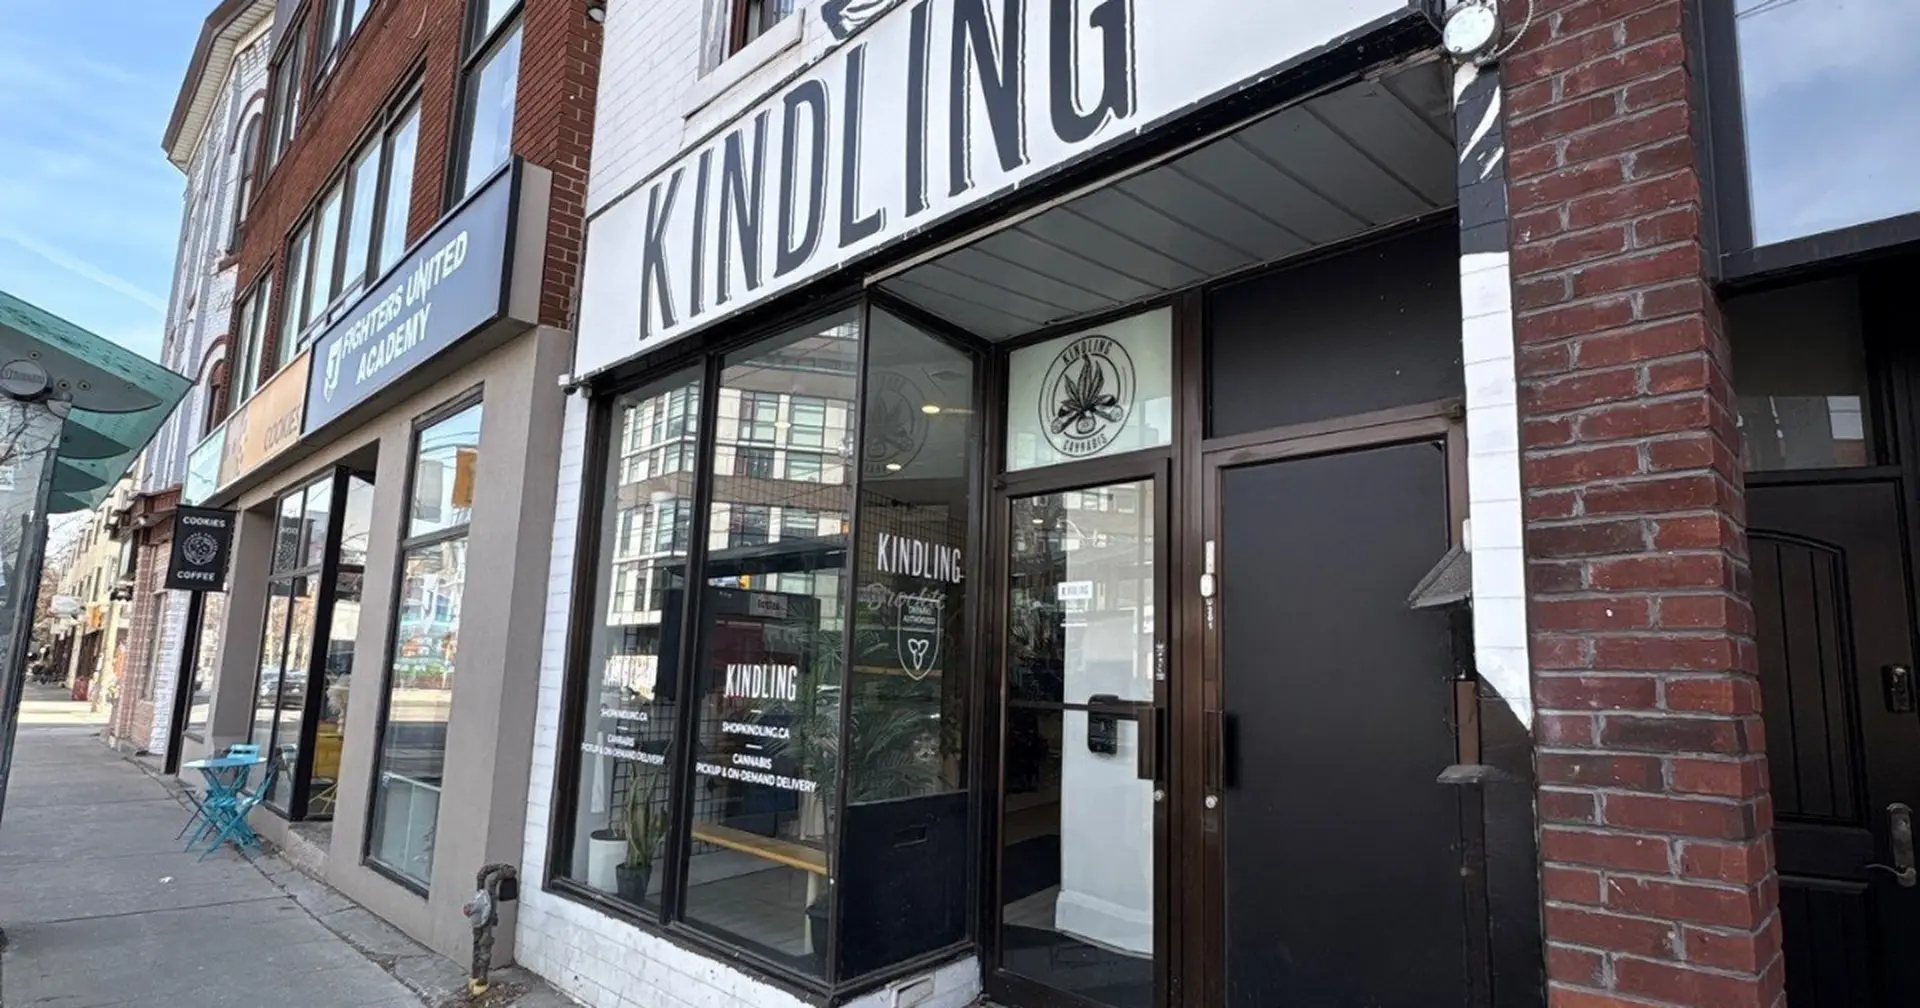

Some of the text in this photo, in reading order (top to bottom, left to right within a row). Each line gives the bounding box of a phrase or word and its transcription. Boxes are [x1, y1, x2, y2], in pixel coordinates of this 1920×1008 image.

[639, 0, 1139, 341] KINDLING
[342, 231, 468, 359] FIGHTERS UNITED
[356, 302, 431, 385] ACADEMY
[1062, 339, 1112, 364] KINDLING
[1063, 433, 1107, 453] CANNABIS
[183, 516, 226, 528] COOKIES
[877, 532, 961, 583] KINDLING
[177, 571, 215, 581] COFFEE
[723, 663, 798, 701] KINDLING
[722, 721, 790, 739] SHOPKINDLING.CA
[732, 753, 772, 770] CANNABIS
[696, 762, 721, 776] PICKUP
[728, 768, 775, 786] ON-DEMAND
[776, 775, 816, 793] DELIVERY
